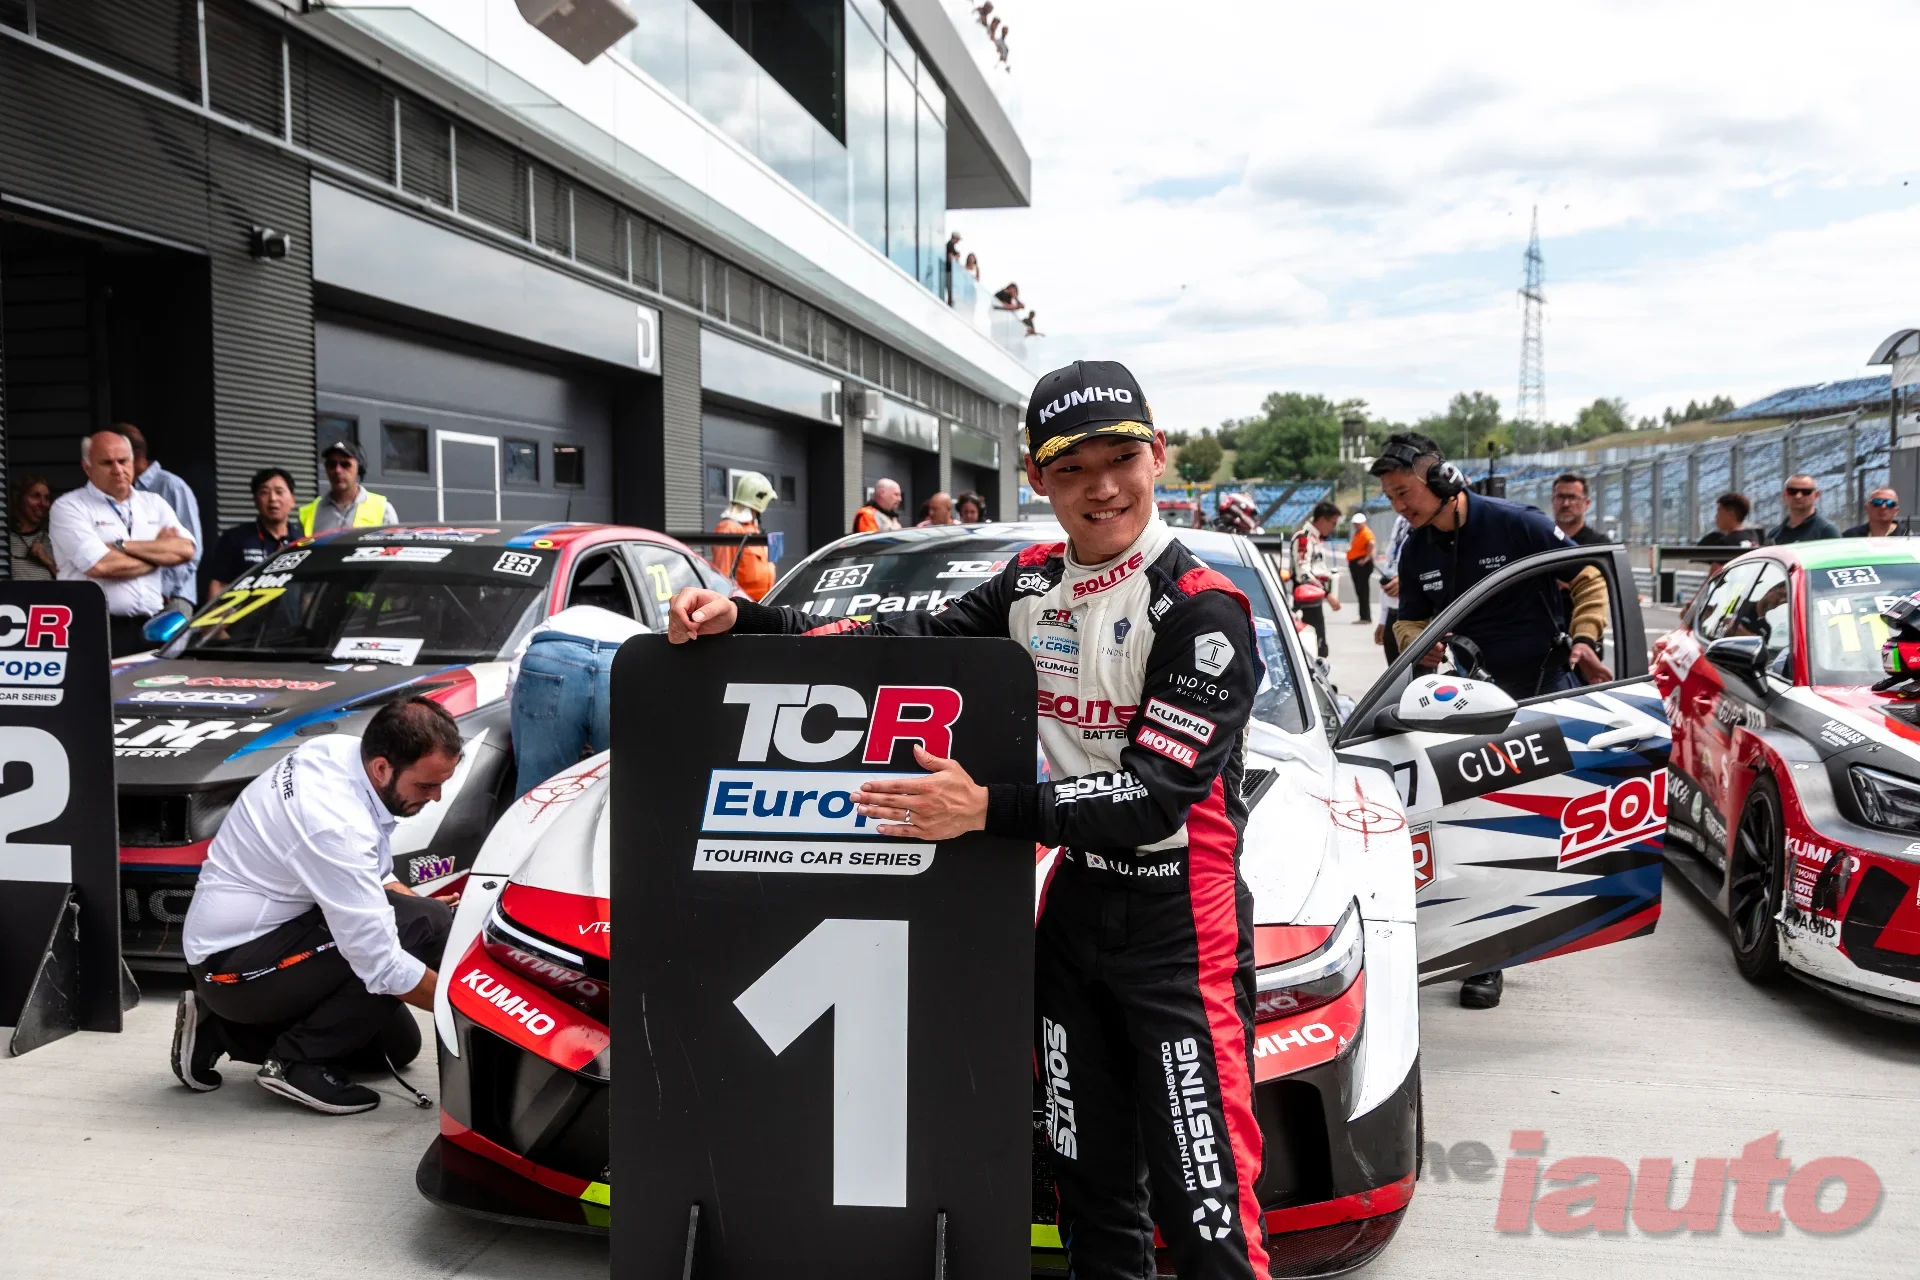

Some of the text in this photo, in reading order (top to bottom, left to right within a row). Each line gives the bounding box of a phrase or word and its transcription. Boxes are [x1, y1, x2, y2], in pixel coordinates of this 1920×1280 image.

[637, 305, 656, 369] D
[1039, 386, 1133, 425] KUMHO
[1072, 552, 1144, 600] SOLITE
[189, 587, 287, 629] 27
[845, 589, 960, 617] Park
[1042, 607, 1073, 624] TCR
[1036, 660, 1079, 675] KUMHO
[1168, 672, 1229, 701] INDIGO
[21, 693, 57, 702] SERIES
[1038, 689, 1138, 728] SOITE
[1175, 687, 1209, 704] RACING
[722, 682, 964, 765] TCR
[1148, 704, 1210, 737] KUMHO
[1138, 729, 1194, 764] MOTUL
[0, 725, 73, 884] 2
[416, 855, 456, 884] KW
[702, 849, 922, 867] TOURING CAR SERIES
[1137, 861, 1181, 877] PARK
[460, 968, 556, 1036] KUMHO
[733, 919, 909, 1208] 1
[1043, 1016, 1078, 1161] SOLITE
[1161, 1041, 1198, 1192] HYUNDAI SUNGWOO
[1174, 1037, 1223, 1190] CASTING
